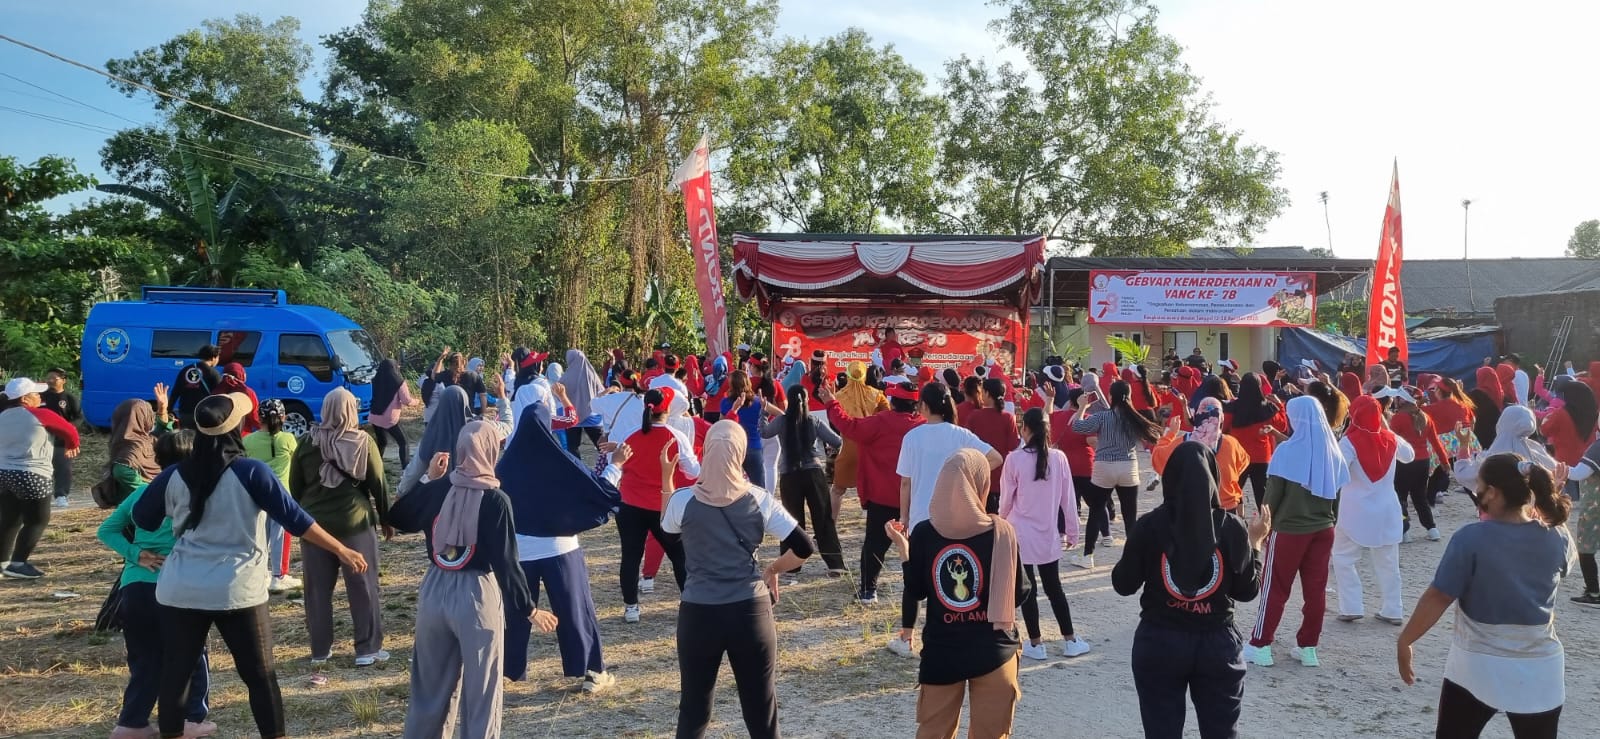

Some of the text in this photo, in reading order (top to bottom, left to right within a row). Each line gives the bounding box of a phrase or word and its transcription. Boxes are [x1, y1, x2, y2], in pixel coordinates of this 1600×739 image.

[1173, 278, 1261, 288] KEMERDEKAAN
[1264, 278, 1277, 287] RI
[1198, 290, 1219, 299] KE-
[1222, 290, 1238, 299] 78
[1378, 237, 1398, 349] HON
[800, 315, 862, 331] GEBYAR
[865, 314, 981, 330] KEMERDEKAAN
[928, 332, 948, 347] 78
